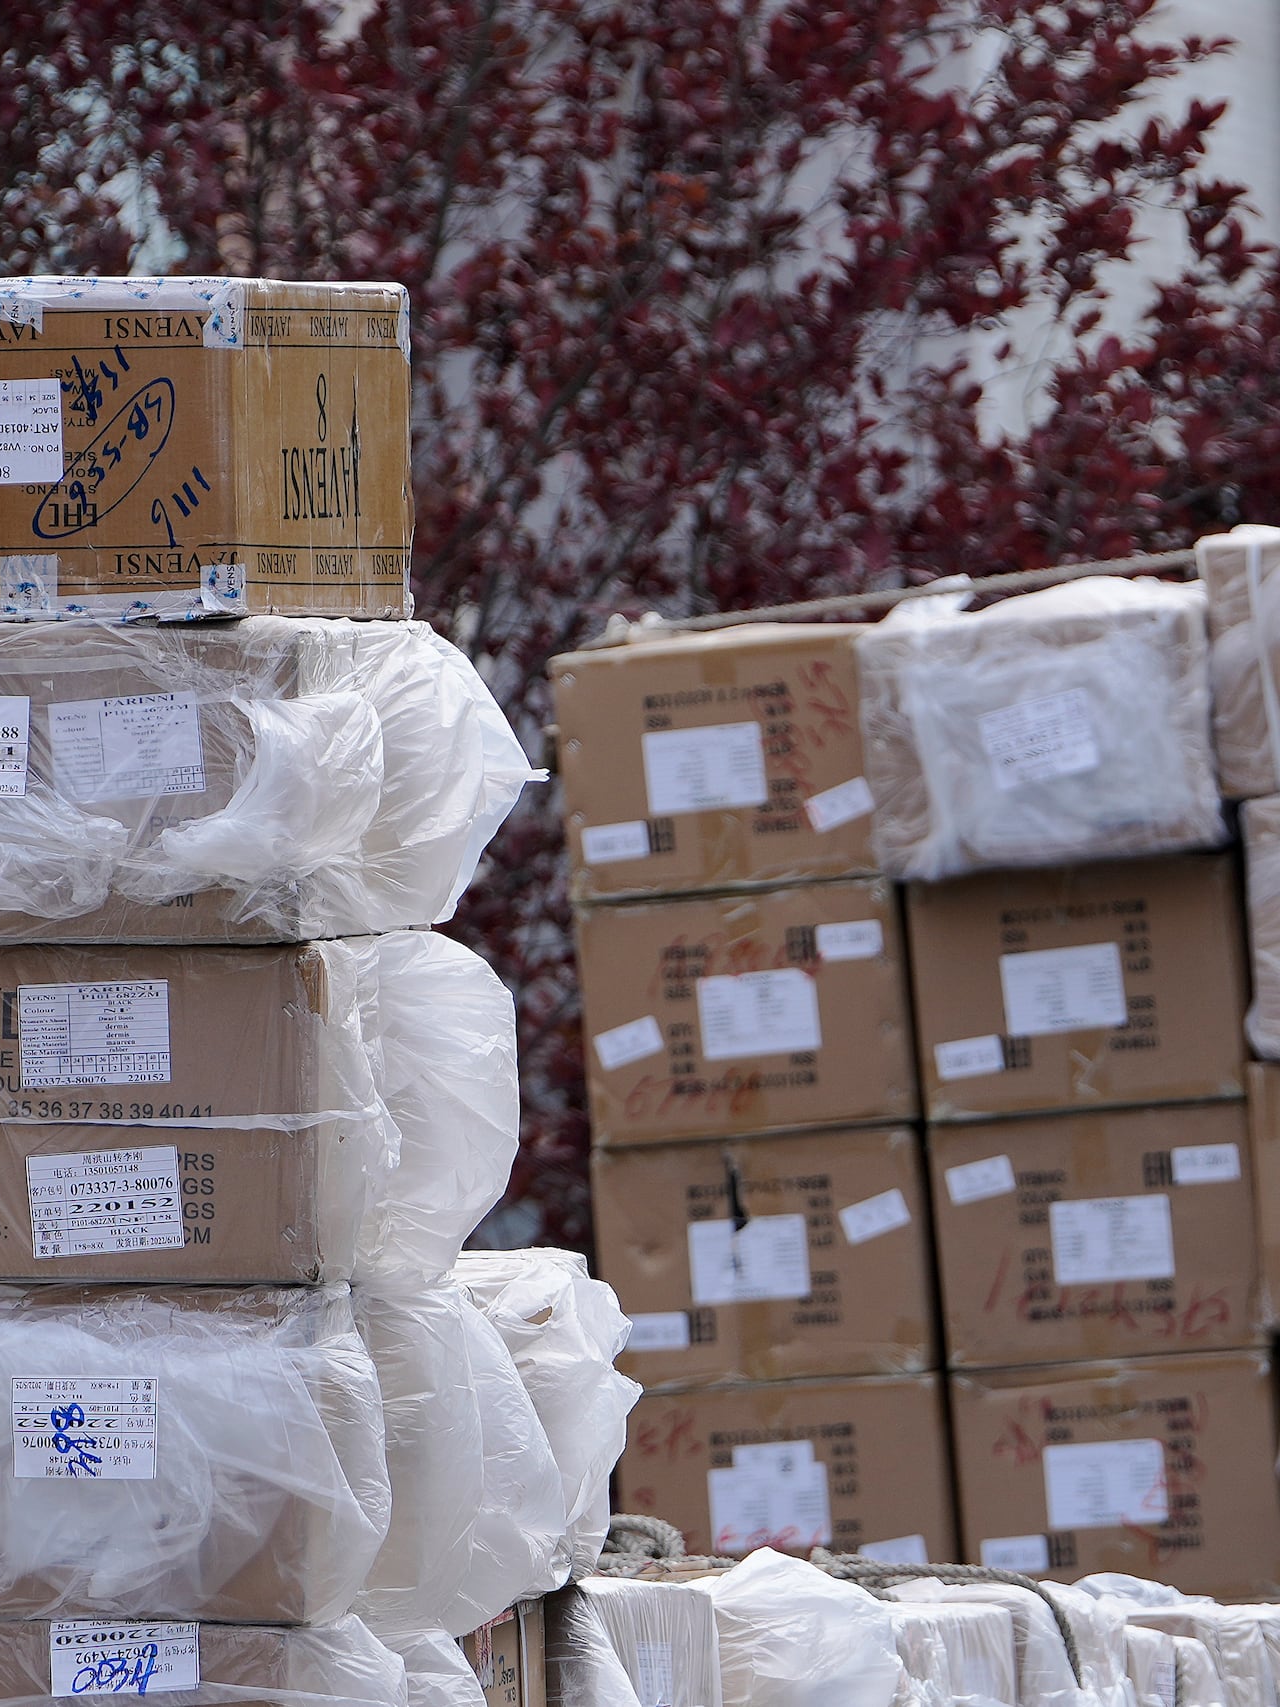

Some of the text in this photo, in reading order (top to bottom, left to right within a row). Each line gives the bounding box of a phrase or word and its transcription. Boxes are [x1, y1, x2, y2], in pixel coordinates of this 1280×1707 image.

[32, 407, 59, 415] BLACK
[317, 373, 327, 443] 8
[46, 443, 59, 452] PO
[21, 484, 48, 497] NO:
[103, 694, 175, 707] FARINNI
[78, 985, 154, 993] FARINNI
[24, 994, 57, 1002] Art.No
[24, 1073, 165, 1086] 073337-3-80076 220152
[8, 1100, 32, 1118] 35
[38, 1101, 62, 1118] 36
[68, 1102, 91, 1119] 37
[99, 1102, 123, 1119] 38
[129, 1103, 153, 1119] 39
[160, 1104, 184, 1119] 40
[190, 1105, 212, 1119] 41
[83, 1164, 139, 1177] 13501057148
[70, 1176, 173, 1197] 073337-3-80076
[181, 1177, 215, 1195] GS
[69, 1197, 175, 1216] 220152
[181, 1201, 215, 1219] GS
[109, 1226, 148, 1236] BLACK
[56, 1628, 161, 1645] 220020
